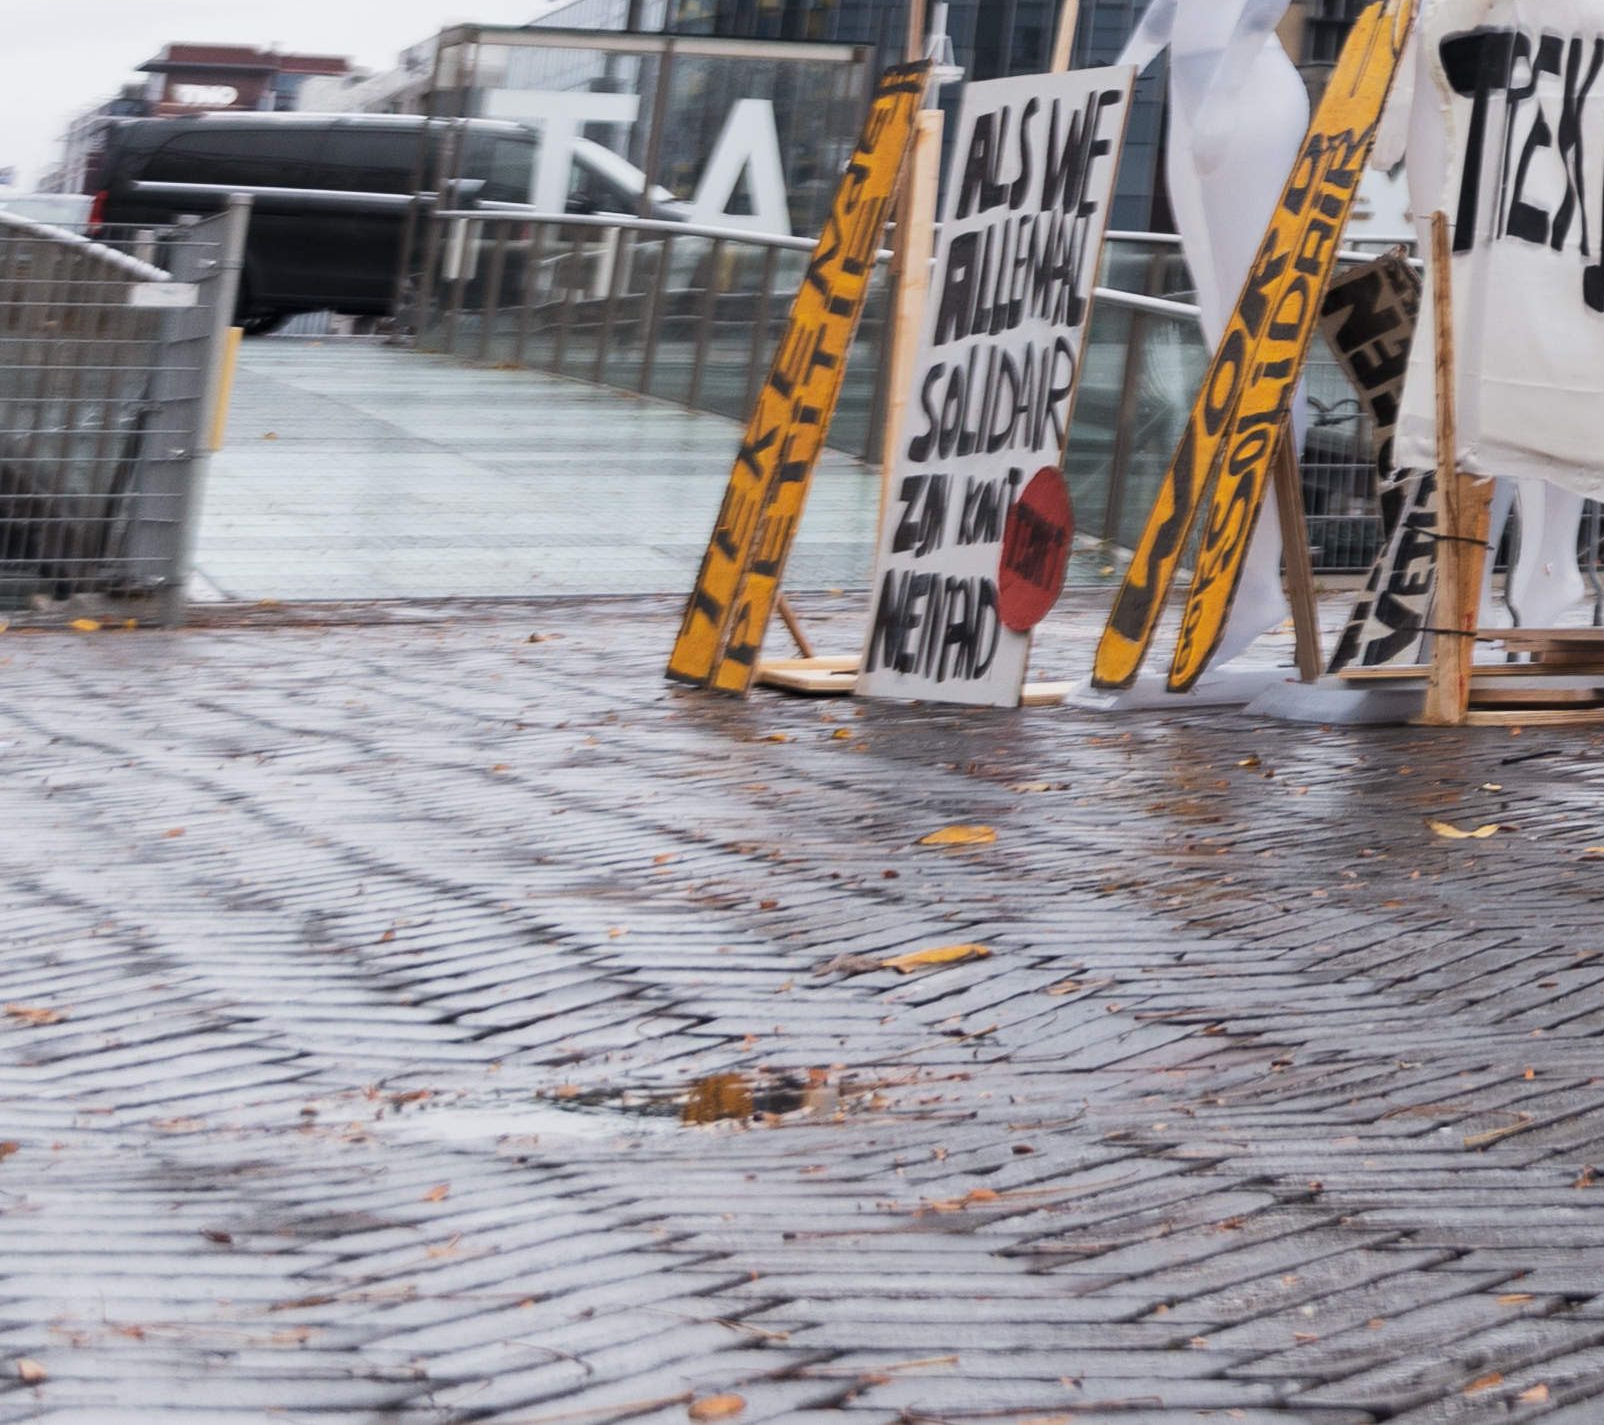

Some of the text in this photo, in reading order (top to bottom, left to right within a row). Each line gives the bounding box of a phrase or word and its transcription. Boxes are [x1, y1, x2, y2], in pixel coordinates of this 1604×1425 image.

[955, 88, 1124, 221] ALS WE
[907, 335, 1077, 463] SOLIDAIR
[1110, 129, 1328, 644] WORD
